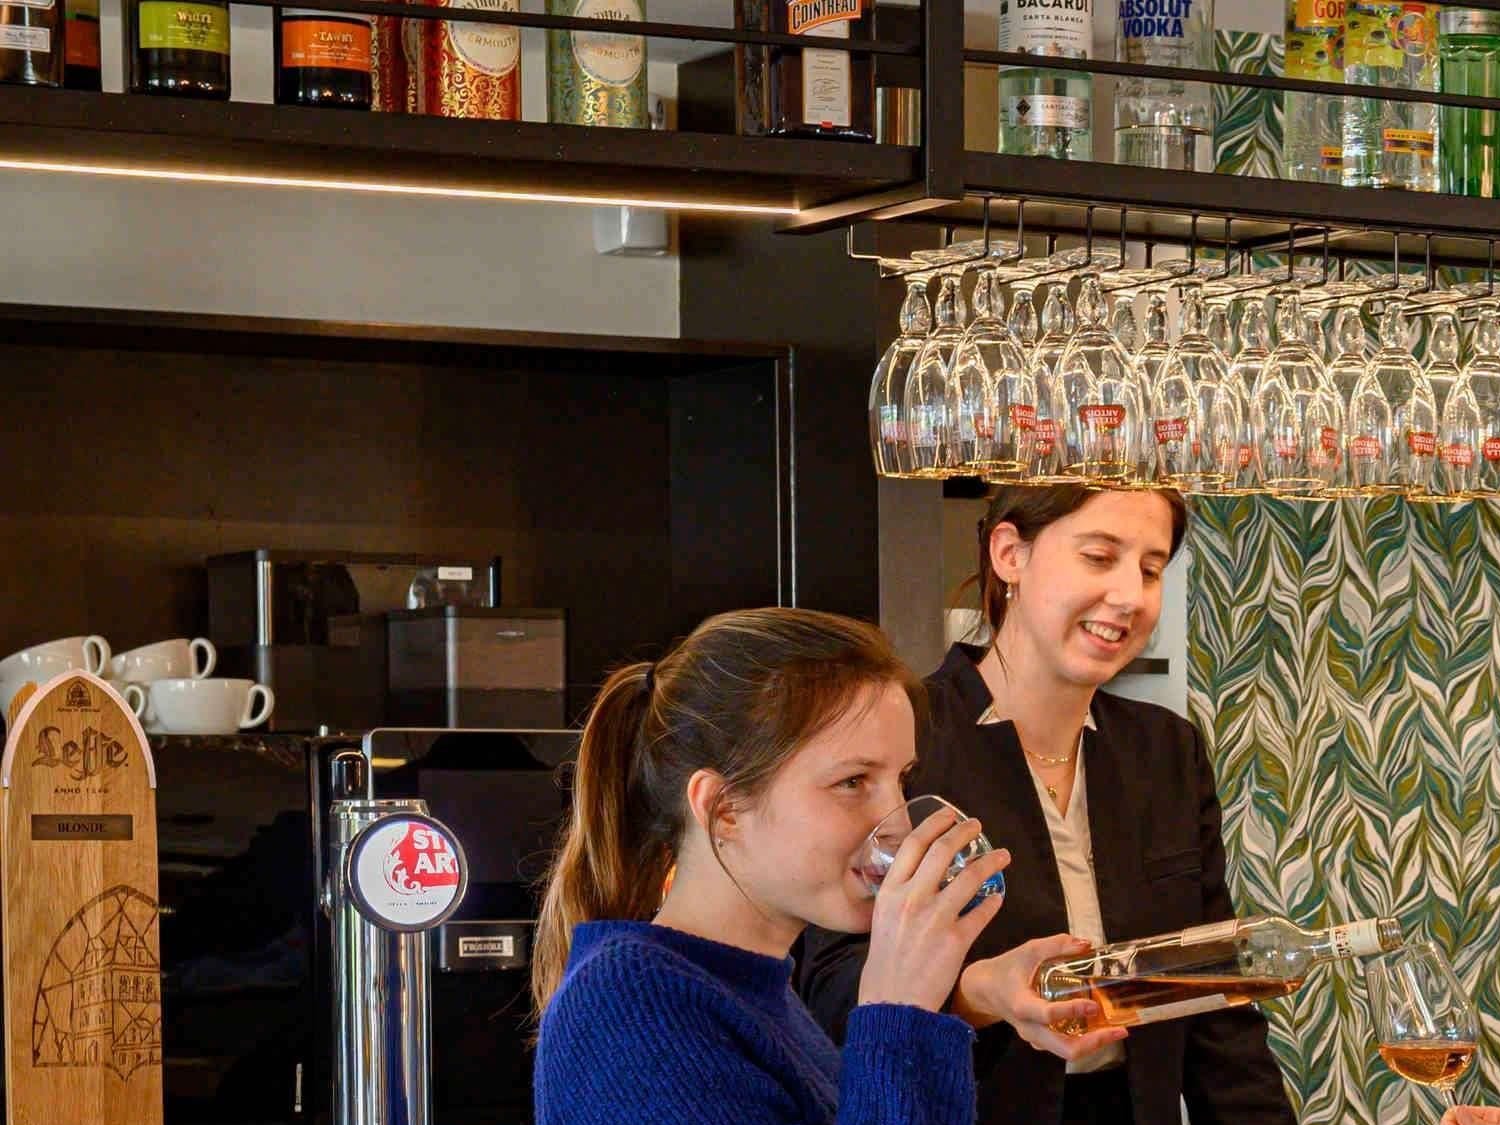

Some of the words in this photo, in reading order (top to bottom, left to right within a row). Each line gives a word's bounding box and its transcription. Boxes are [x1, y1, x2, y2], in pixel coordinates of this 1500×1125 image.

[1118, 0, 1193, 18] ABSOLUT
[1123, 18, 1185, 38] VODKA
[32, 726, 128, 781] Leffe
[57, 822, 106, 834] BLONDE
